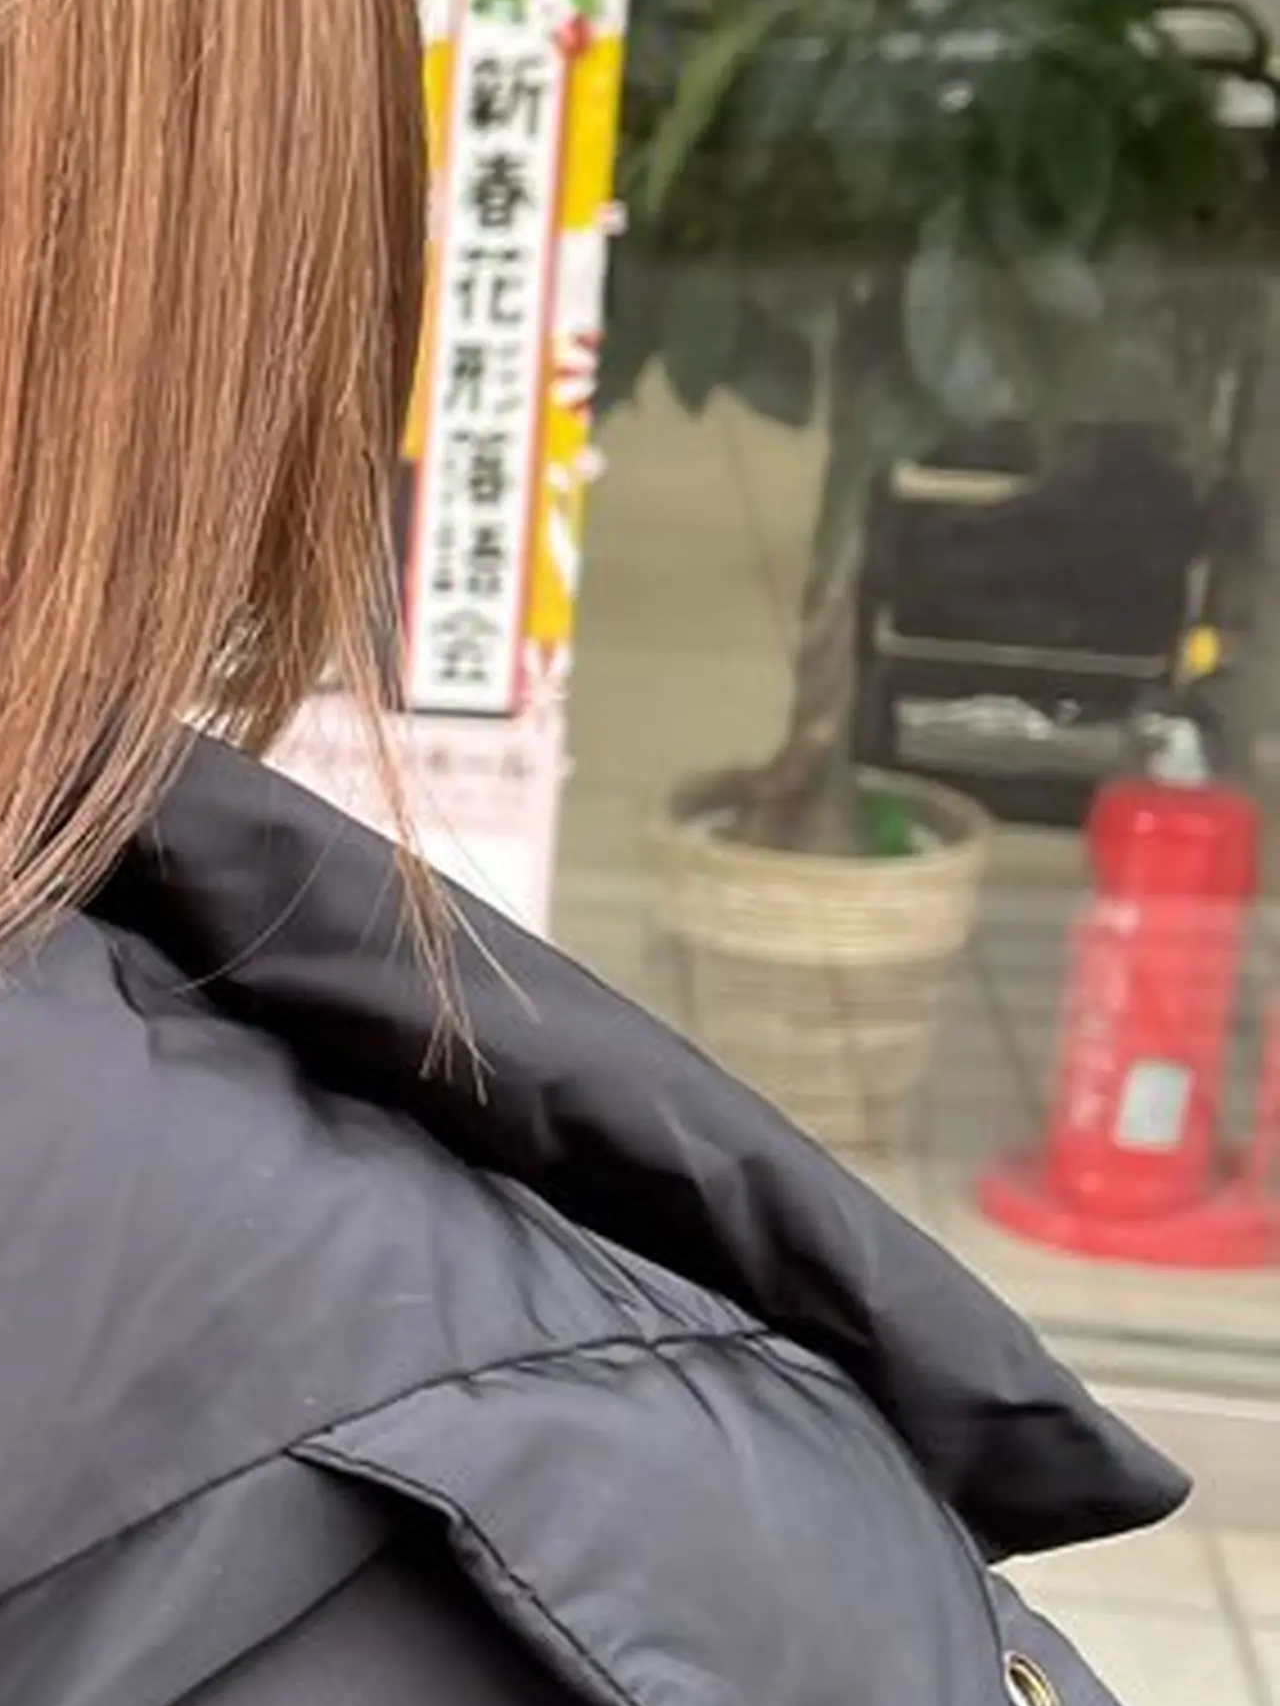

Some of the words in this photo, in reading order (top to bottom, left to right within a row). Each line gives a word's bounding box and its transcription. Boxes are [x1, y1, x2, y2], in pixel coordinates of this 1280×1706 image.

[429, 54, 547, 684] 新春花形落語会
